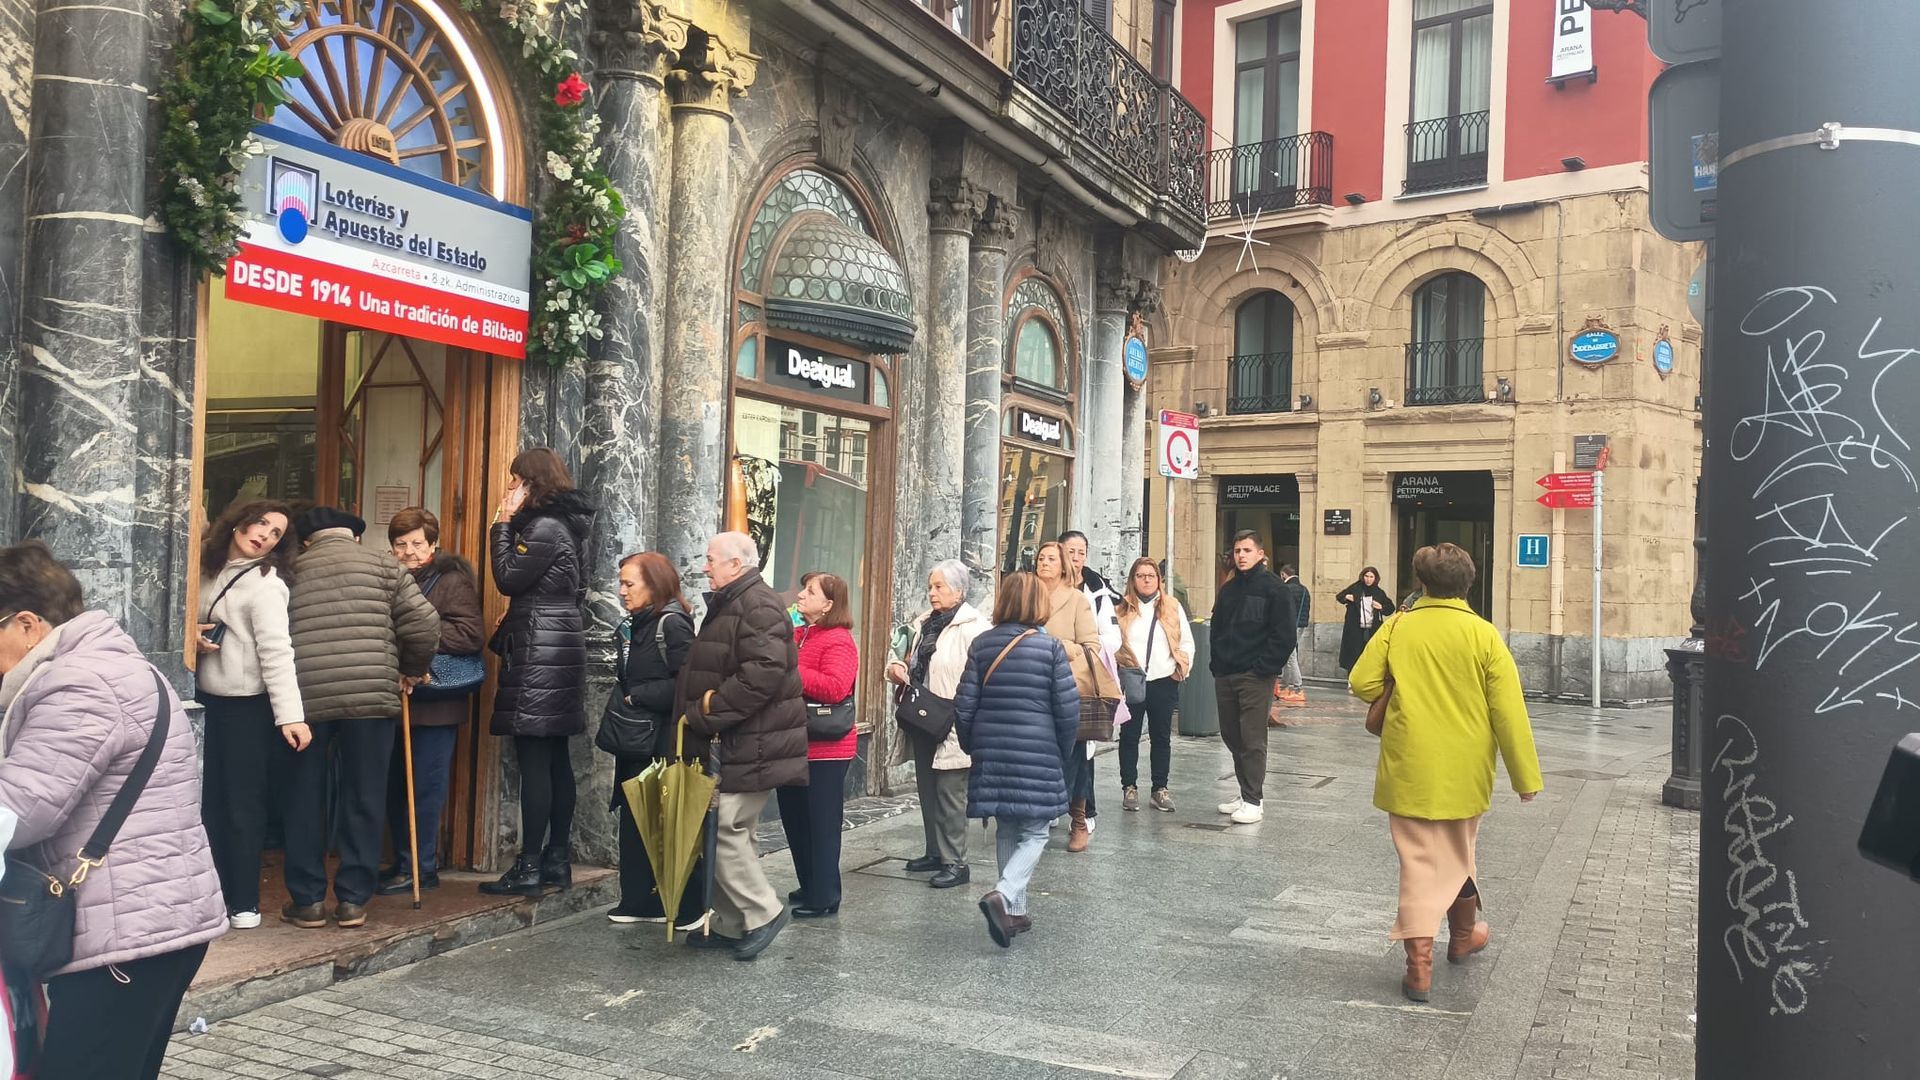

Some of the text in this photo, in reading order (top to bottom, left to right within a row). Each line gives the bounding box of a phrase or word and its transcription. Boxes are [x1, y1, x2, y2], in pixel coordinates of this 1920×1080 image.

[324, 181, 409, 229] Loterías y
[324, 210, 487, 271] Apuestas del Estado
[233, 260, 523, 344] DESDE 1914 Una tradición de Bilbao
[371, 258, 421, 281] Azcarreta
[455, 279, 521, 305] Administrazioa
[1227, 484, 1281, 493] PETITPALACE
[1401, 476, 1439, 486] ARANA
[1526, 538, 1540, 555] H
